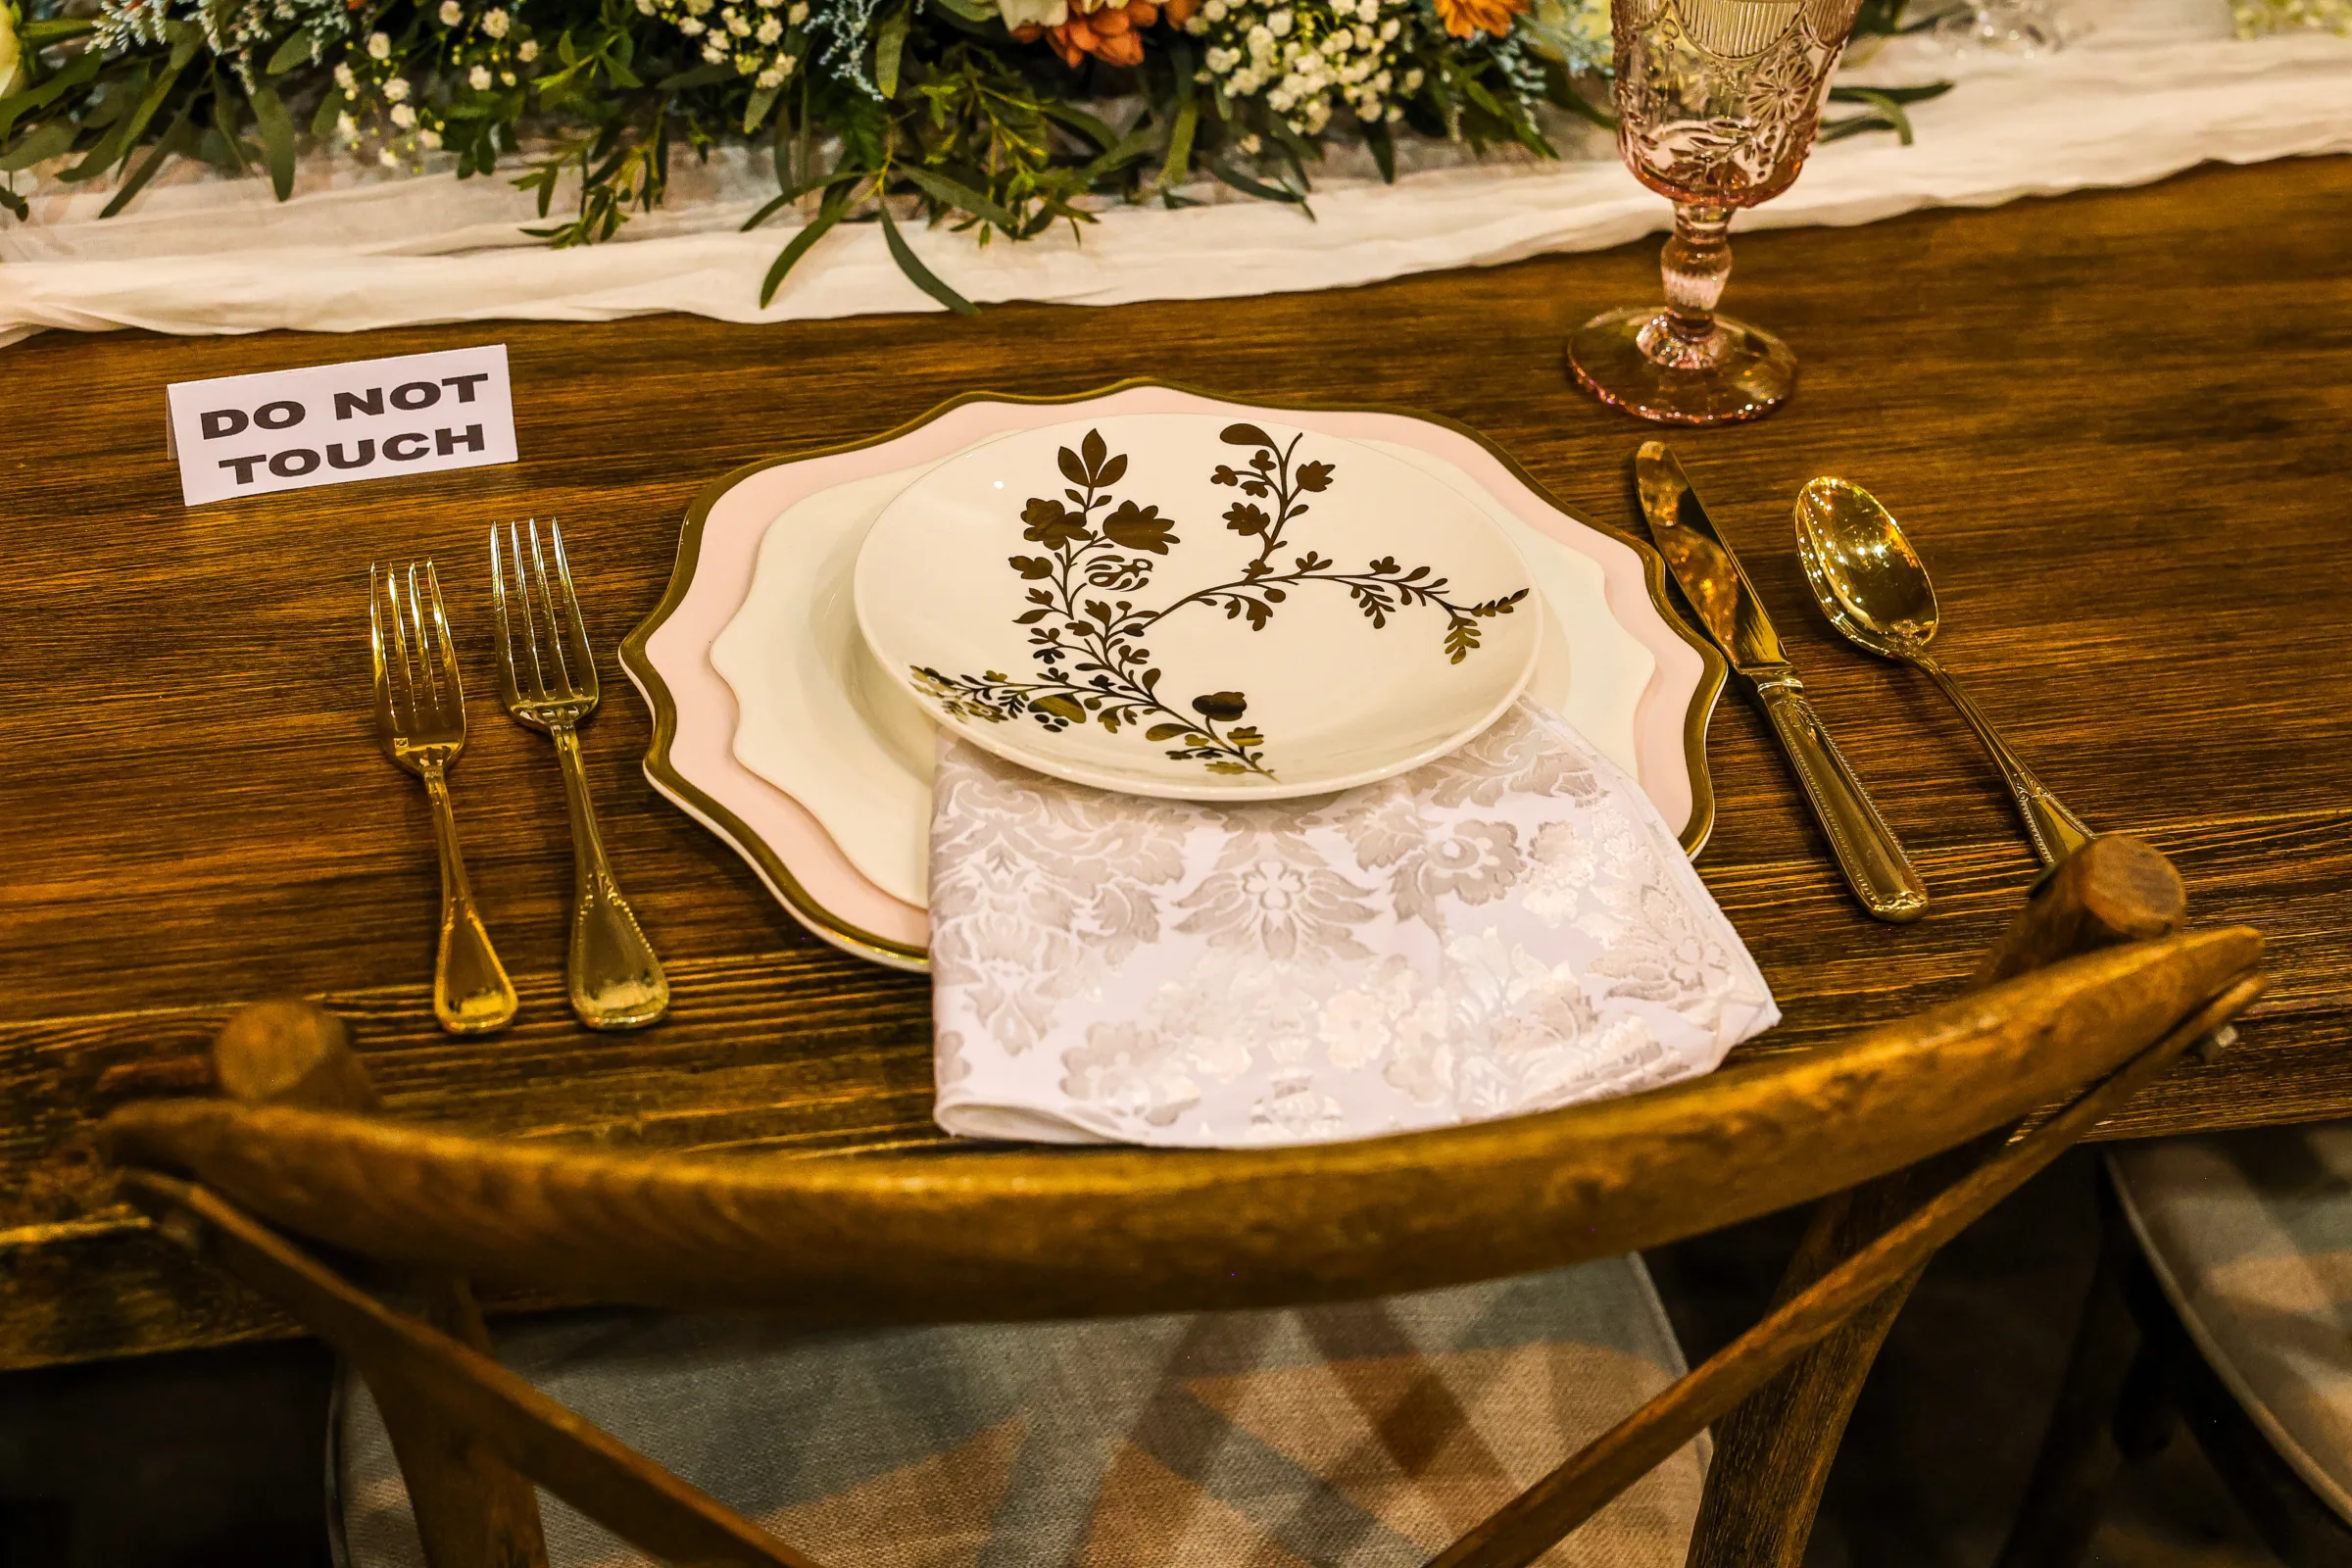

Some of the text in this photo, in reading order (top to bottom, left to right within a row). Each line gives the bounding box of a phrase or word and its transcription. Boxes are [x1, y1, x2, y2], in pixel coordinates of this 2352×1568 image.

[201, 373, 489, 440] DO NOT
[218, 423, 485, 485] TOUCH
